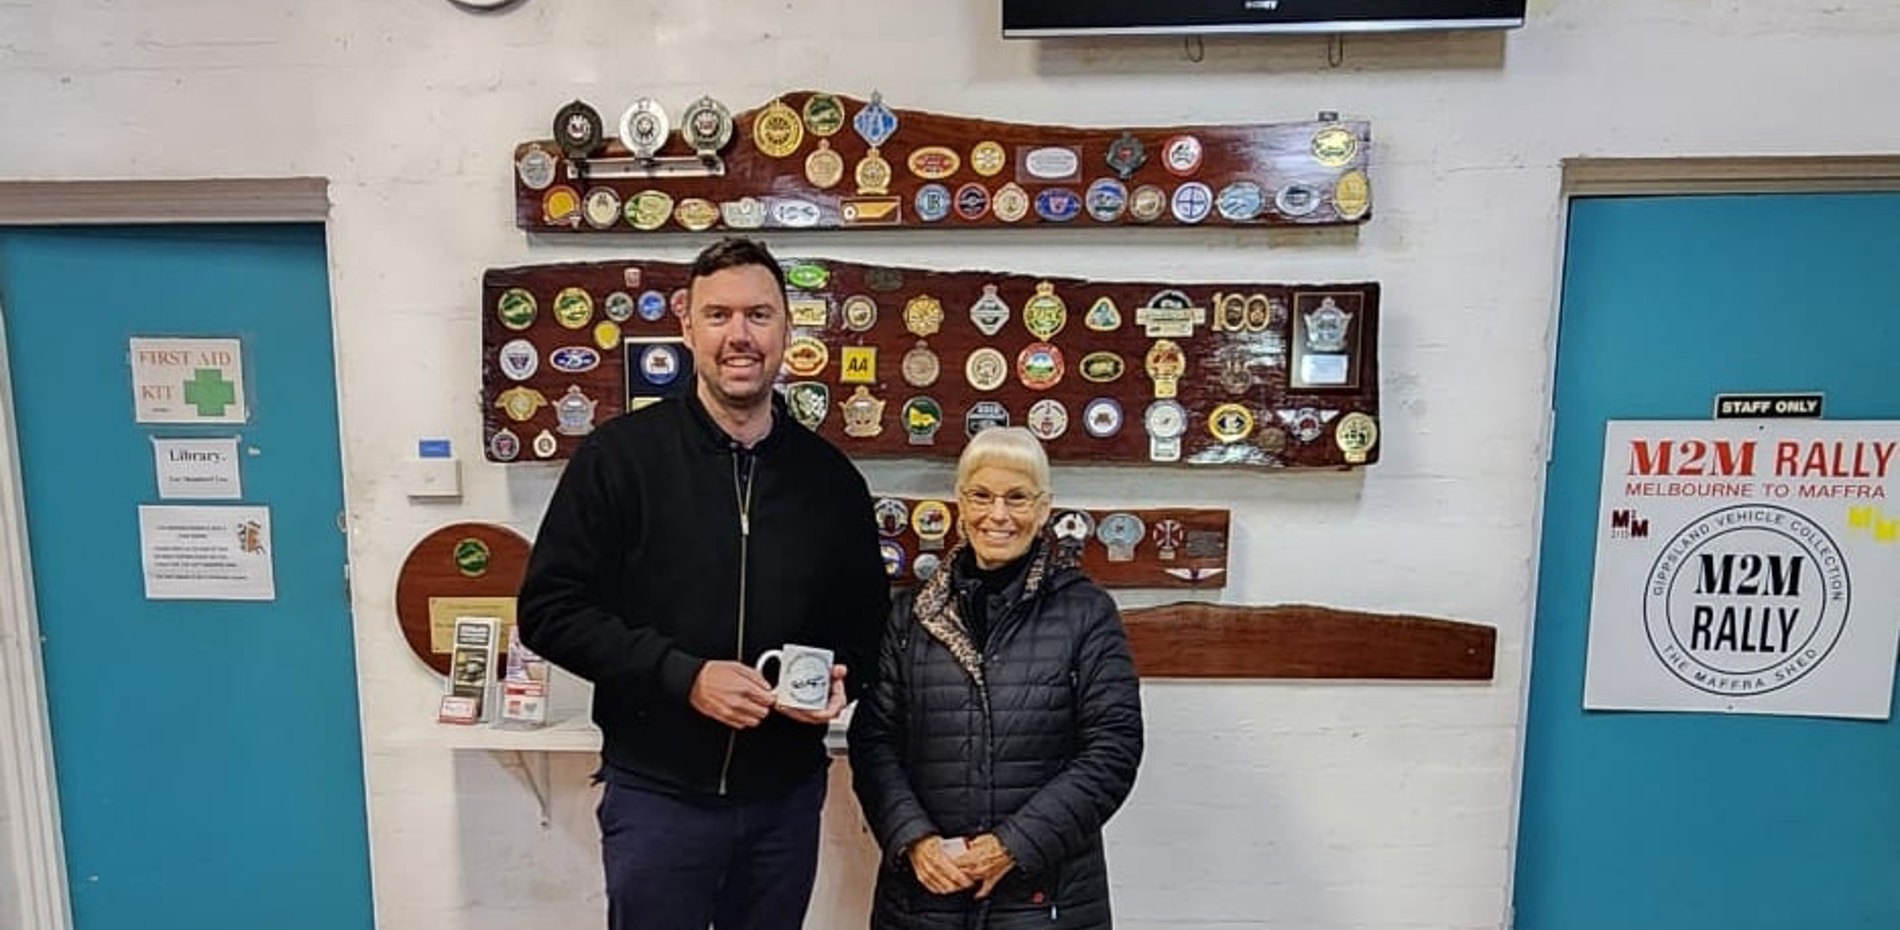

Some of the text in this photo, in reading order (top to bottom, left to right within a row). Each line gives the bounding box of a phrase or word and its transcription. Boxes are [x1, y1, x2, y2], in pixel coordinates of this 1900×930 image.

[1212, 292, 1270, 332] 100
[139, 351, 231, 366] FIRST AID
[846, 357, 868, 372] AA
[142, 385, 173, 400] KIT
[1722, 400, 1818, 414] STAFF ONLY
[1628, 439, 1897, 478] M2M RALLY
[1625, 482, 1886, 499] MELBOURNE TO MAFFRA
[1653, 510, 1845, 601] GIPPSLAND VEHICLE COLLECTION
[1694, 554, 1805, 597] M2M
[1690, 605, 1800, 653] RALLY
[1663, 645, 1818, 691] THE MAFFRA SHED
